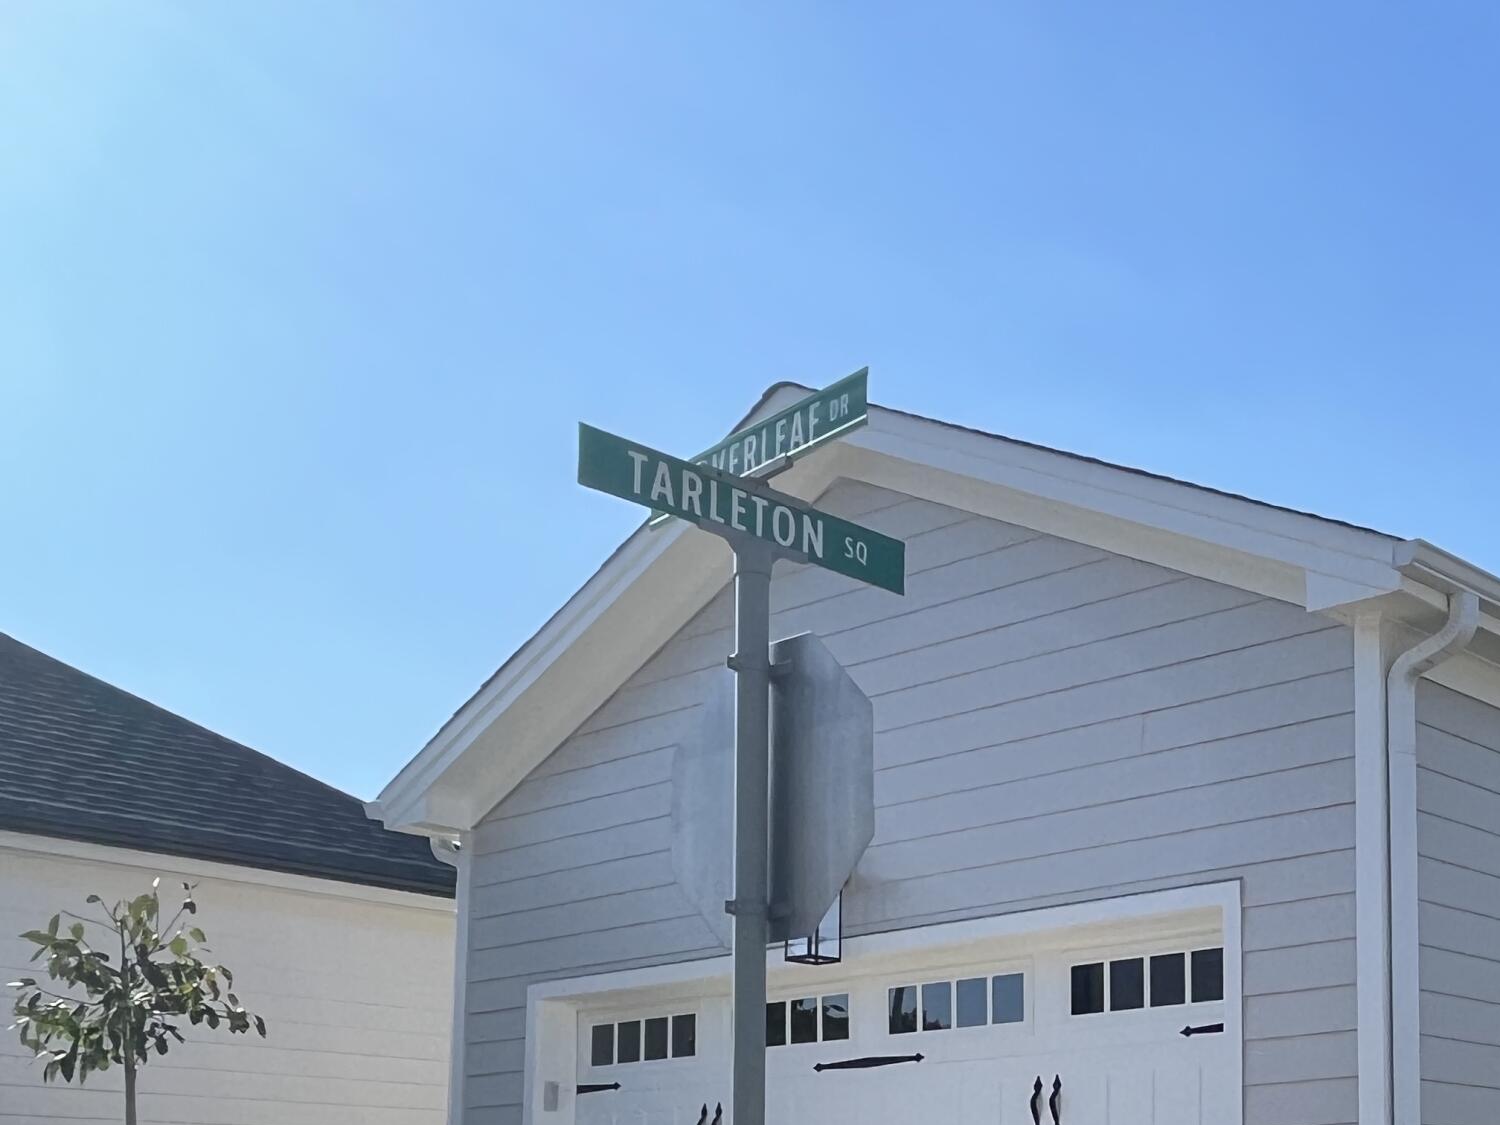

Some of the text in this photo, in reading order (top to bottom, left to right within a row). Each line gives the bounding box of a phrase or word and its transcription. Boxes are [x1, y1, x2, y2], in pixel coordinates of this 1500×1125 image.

[829, 393, 849, 422] DR
[627, 450, 867, 566] TARLETON SQ
